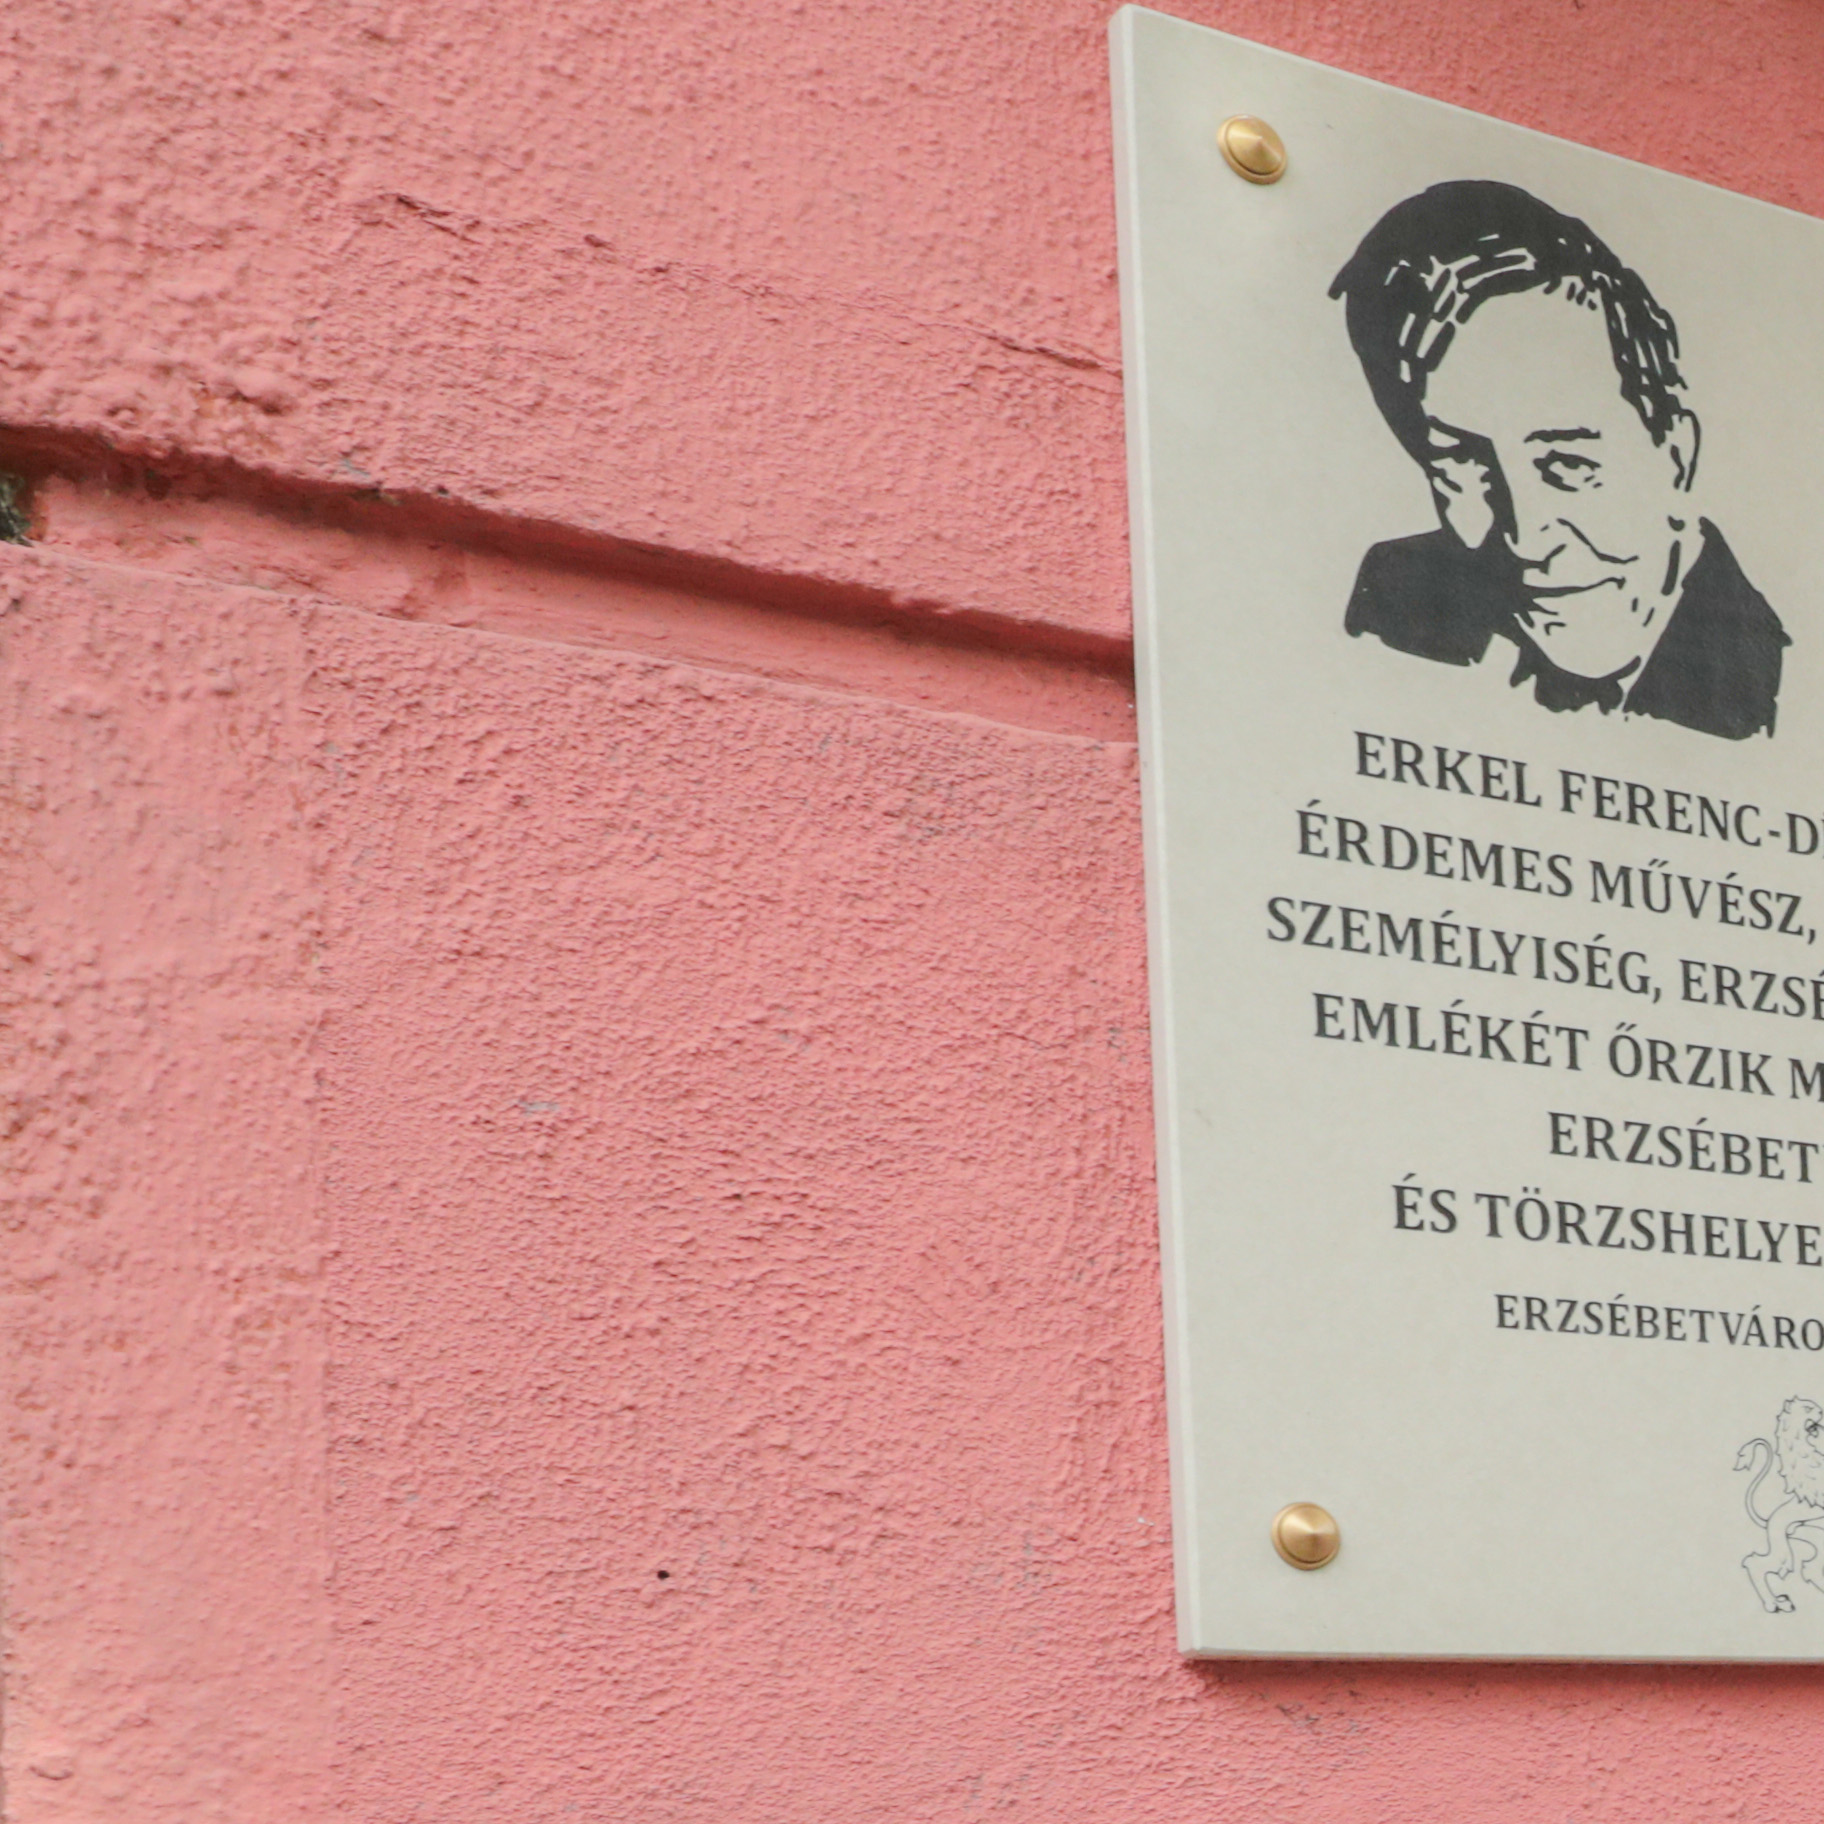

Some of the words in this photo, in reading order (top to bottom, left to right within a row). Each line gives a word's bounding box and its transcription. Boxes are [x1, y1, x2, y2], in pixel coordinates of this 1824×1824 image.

[1354, 731, 1542, 807] ERKEL
[1296, 799, 1573, 897] ÉRDEMES
[1589, 858, 1816, 945] MŰVÉSZ,
[1267, 897, 1661, 1004] SZEMÉLYISÉG,
[1312, 993, 1589, 1071] EMLÉKÉT
[1608, 1022, 1774, 1096] ŐRZIK
[1392, 1173, 1457, 1233] ÉS
[1475, 1186, 1822, 1267] TÖRZSHELYE
